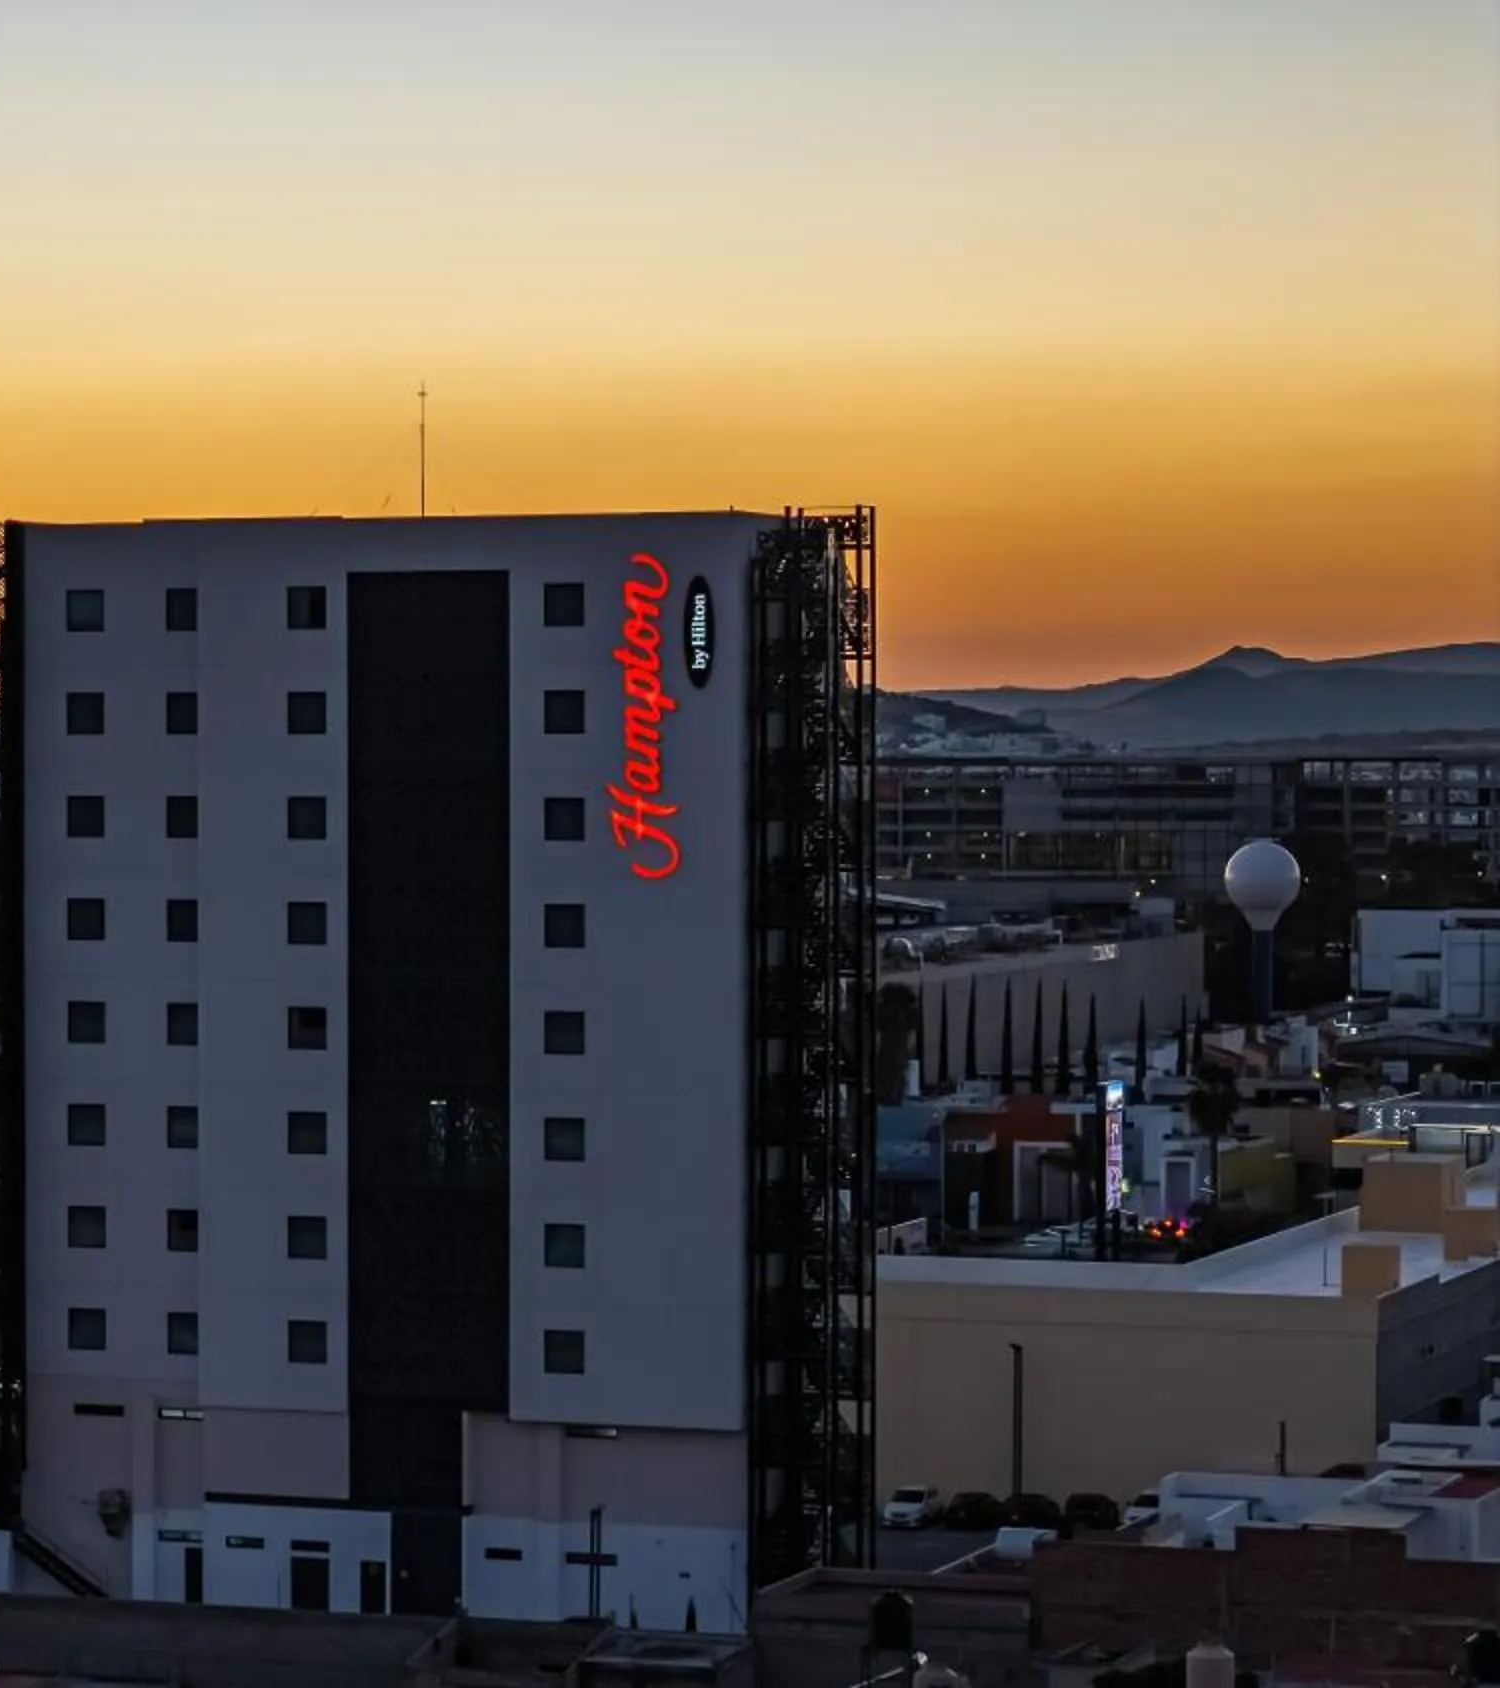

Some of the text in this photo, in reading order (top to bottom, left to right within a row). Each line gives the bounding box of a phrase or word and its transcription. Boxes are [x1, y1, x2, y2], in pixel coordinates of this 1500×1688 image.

[608, 554, 679, 878] Hampton
[691, 593, 710, 670] by Hilton
